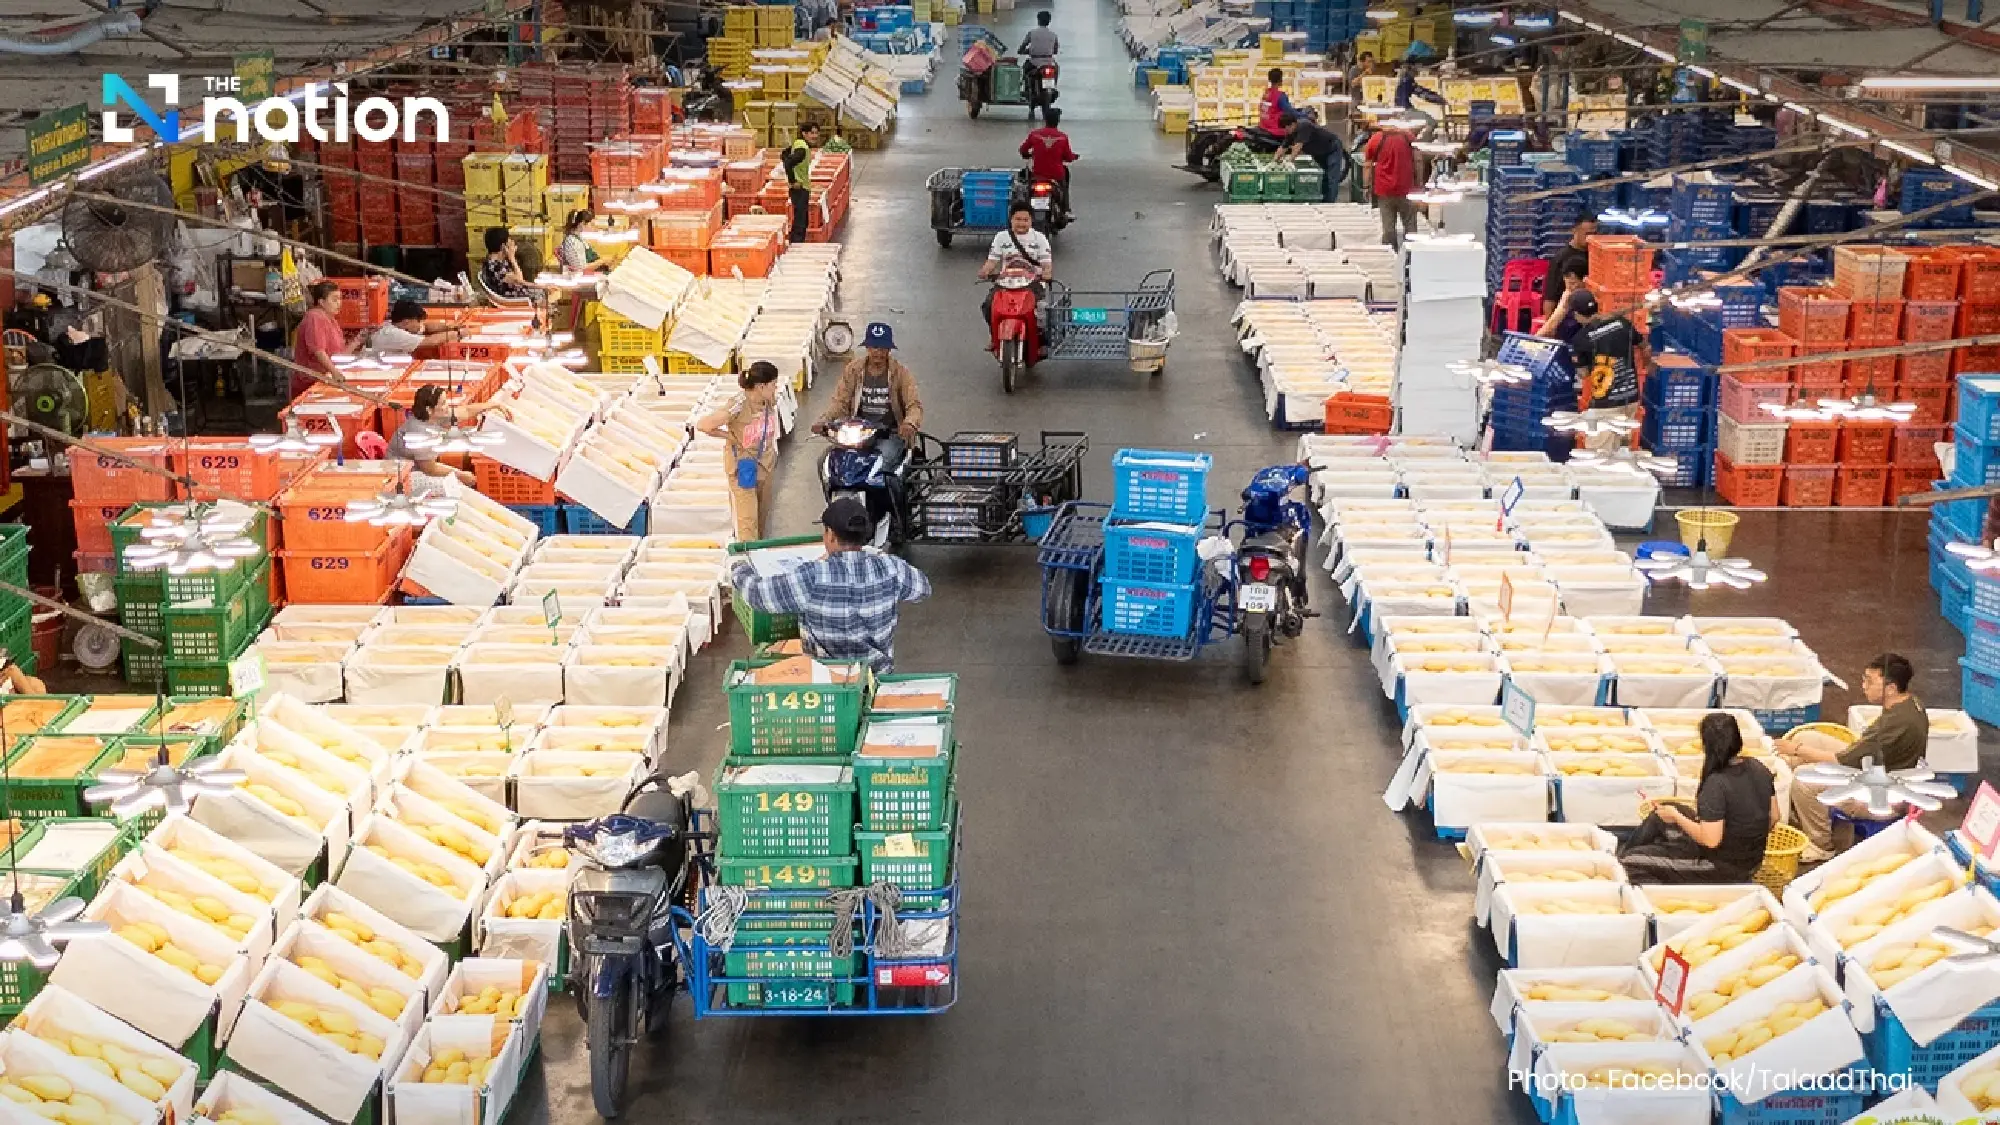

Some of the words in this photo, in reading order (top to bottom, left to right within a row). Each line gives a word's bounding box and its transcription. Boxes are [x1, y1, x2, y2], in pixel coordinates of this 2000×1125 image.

[459, 347, 489, 358] 629
[201, 455, 239, 469] 629
[308, 507, 346, 521] 629
[311, 556, 349, 570] 629
[765, 690, 821, 711] 149
[757, 792, 815, 812] 149
[759, 864, 816, 884] 149
[764, 987, 823, 1003] 3-18-24
